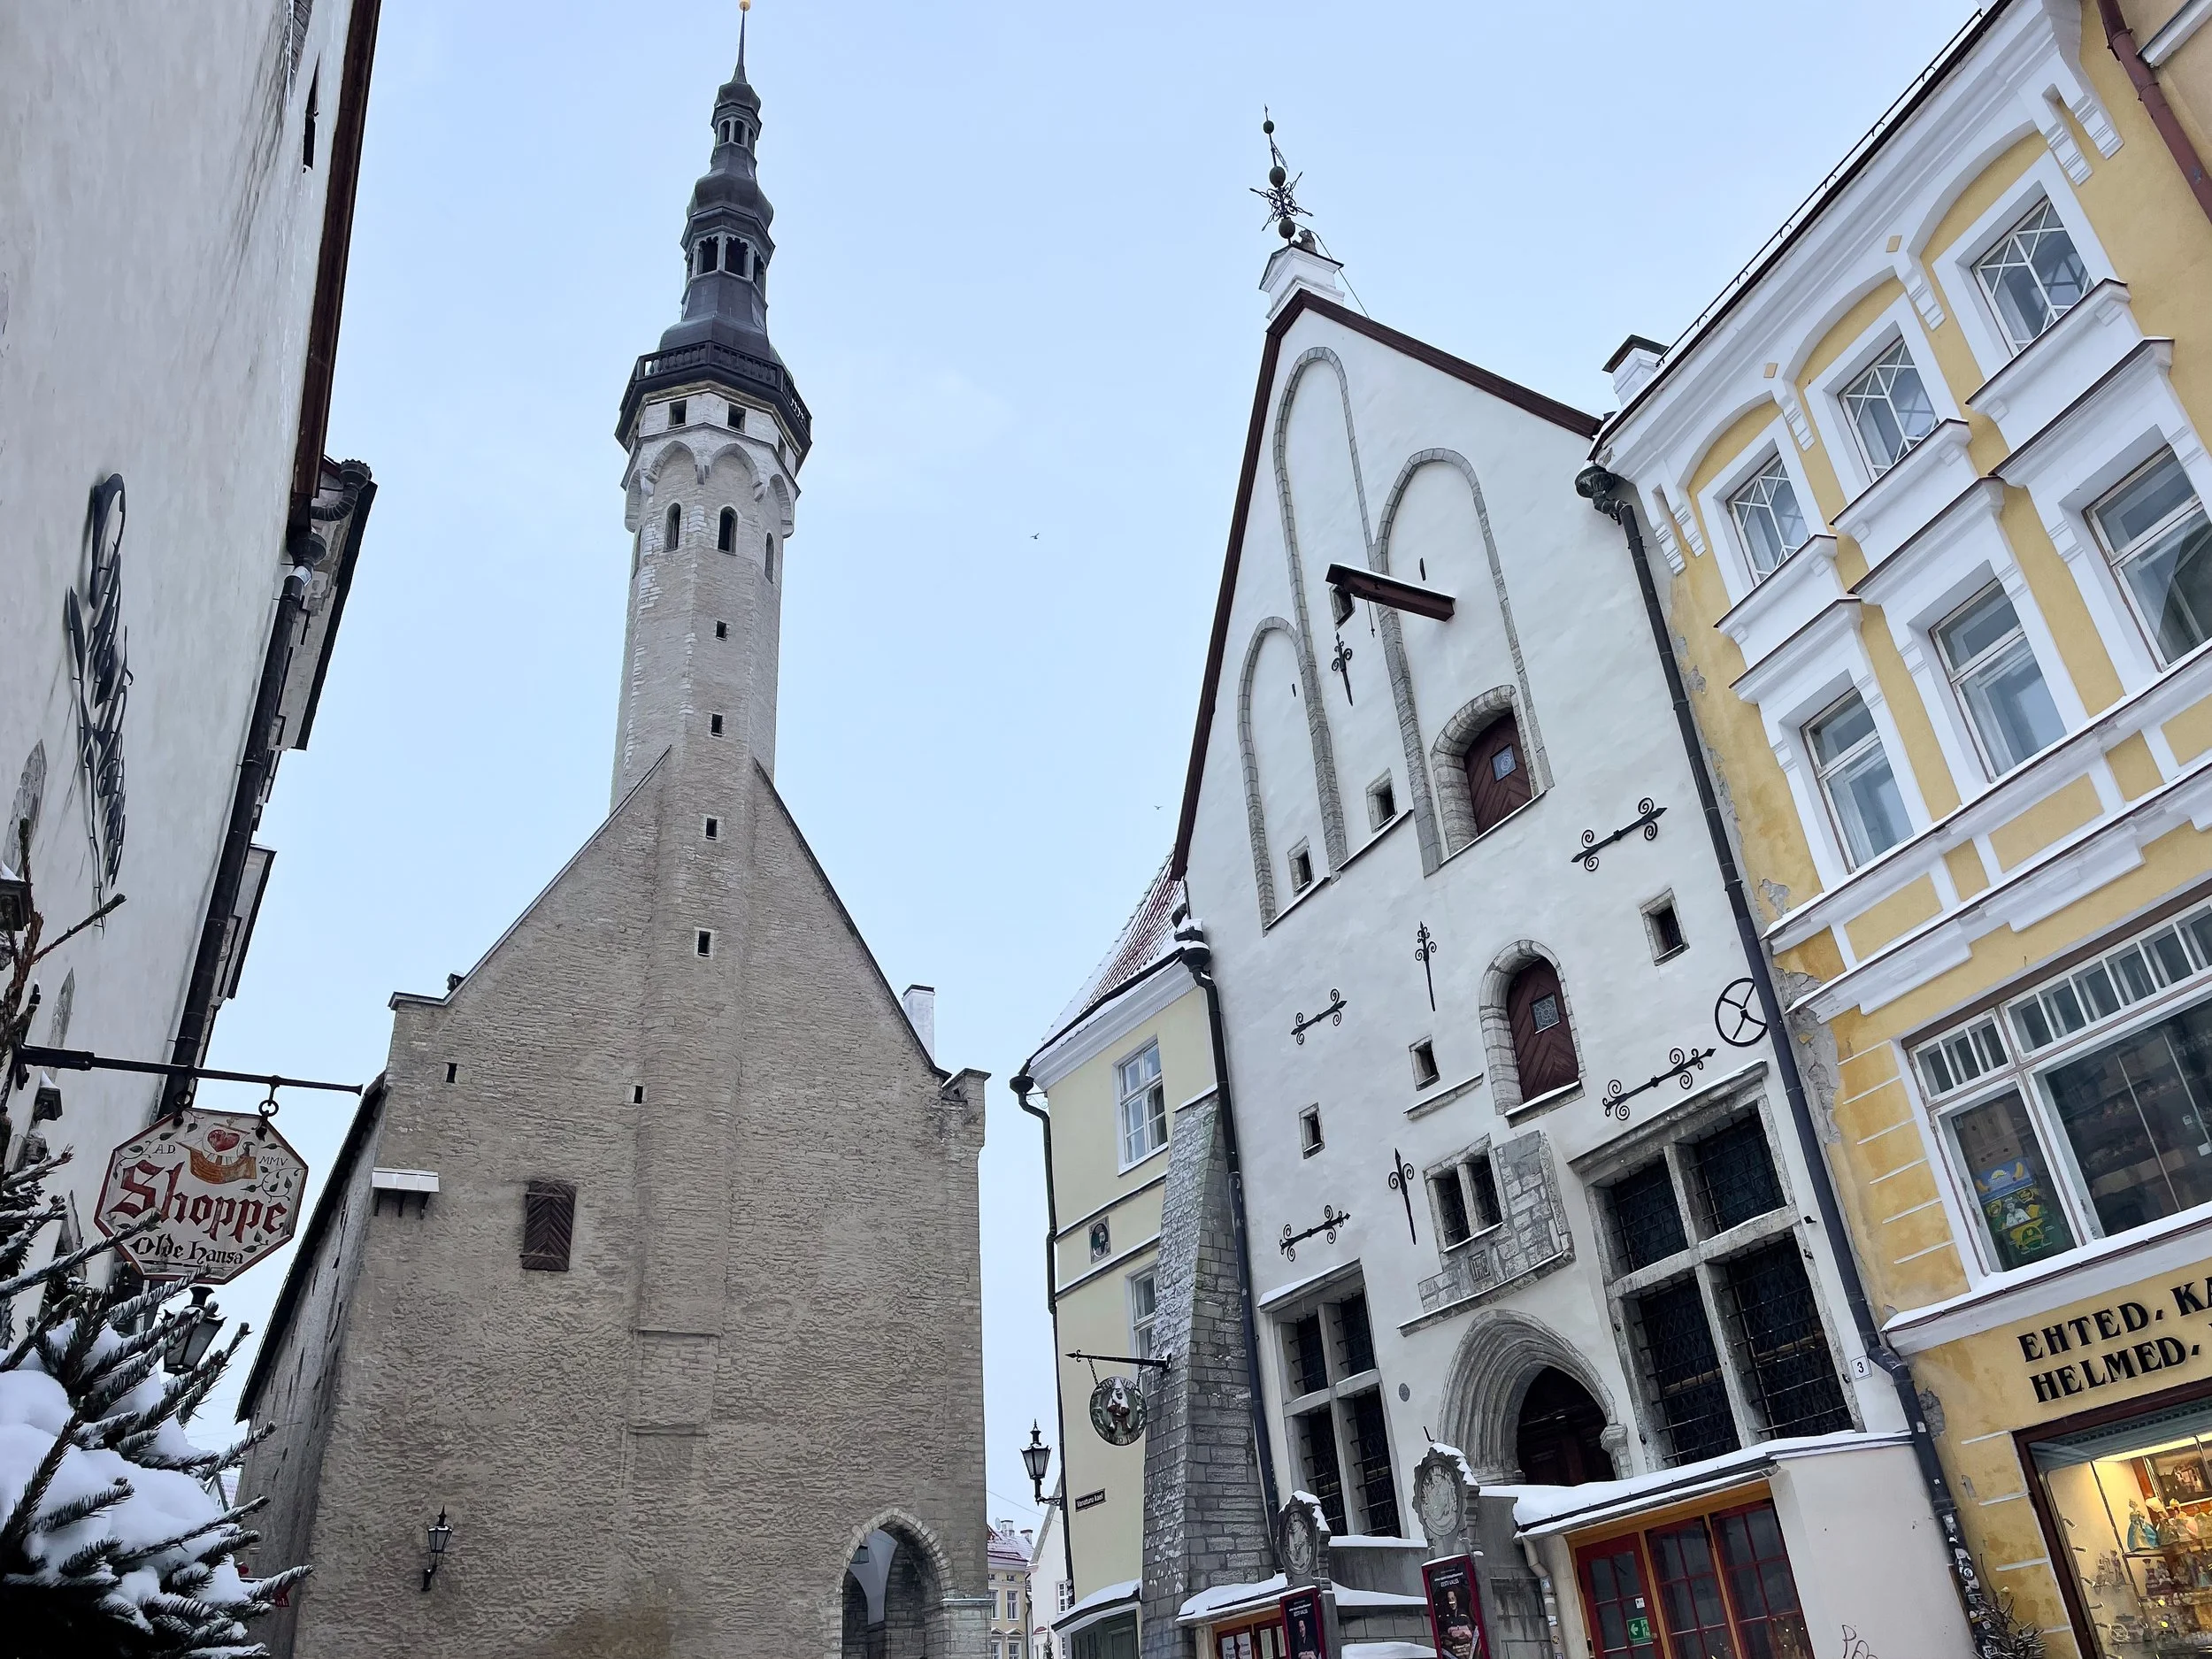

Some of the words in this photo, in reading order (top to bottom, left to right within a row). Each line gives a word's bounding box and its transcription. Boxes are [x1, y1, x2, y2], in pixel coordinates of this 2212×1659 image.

[258, 1156, 288, 1166] MMV
[106, 1160, 287, 1243] Shoppe
[130, 1233, 183, 1260] Olde
[1857, 1362, 1864, 1373] 3
